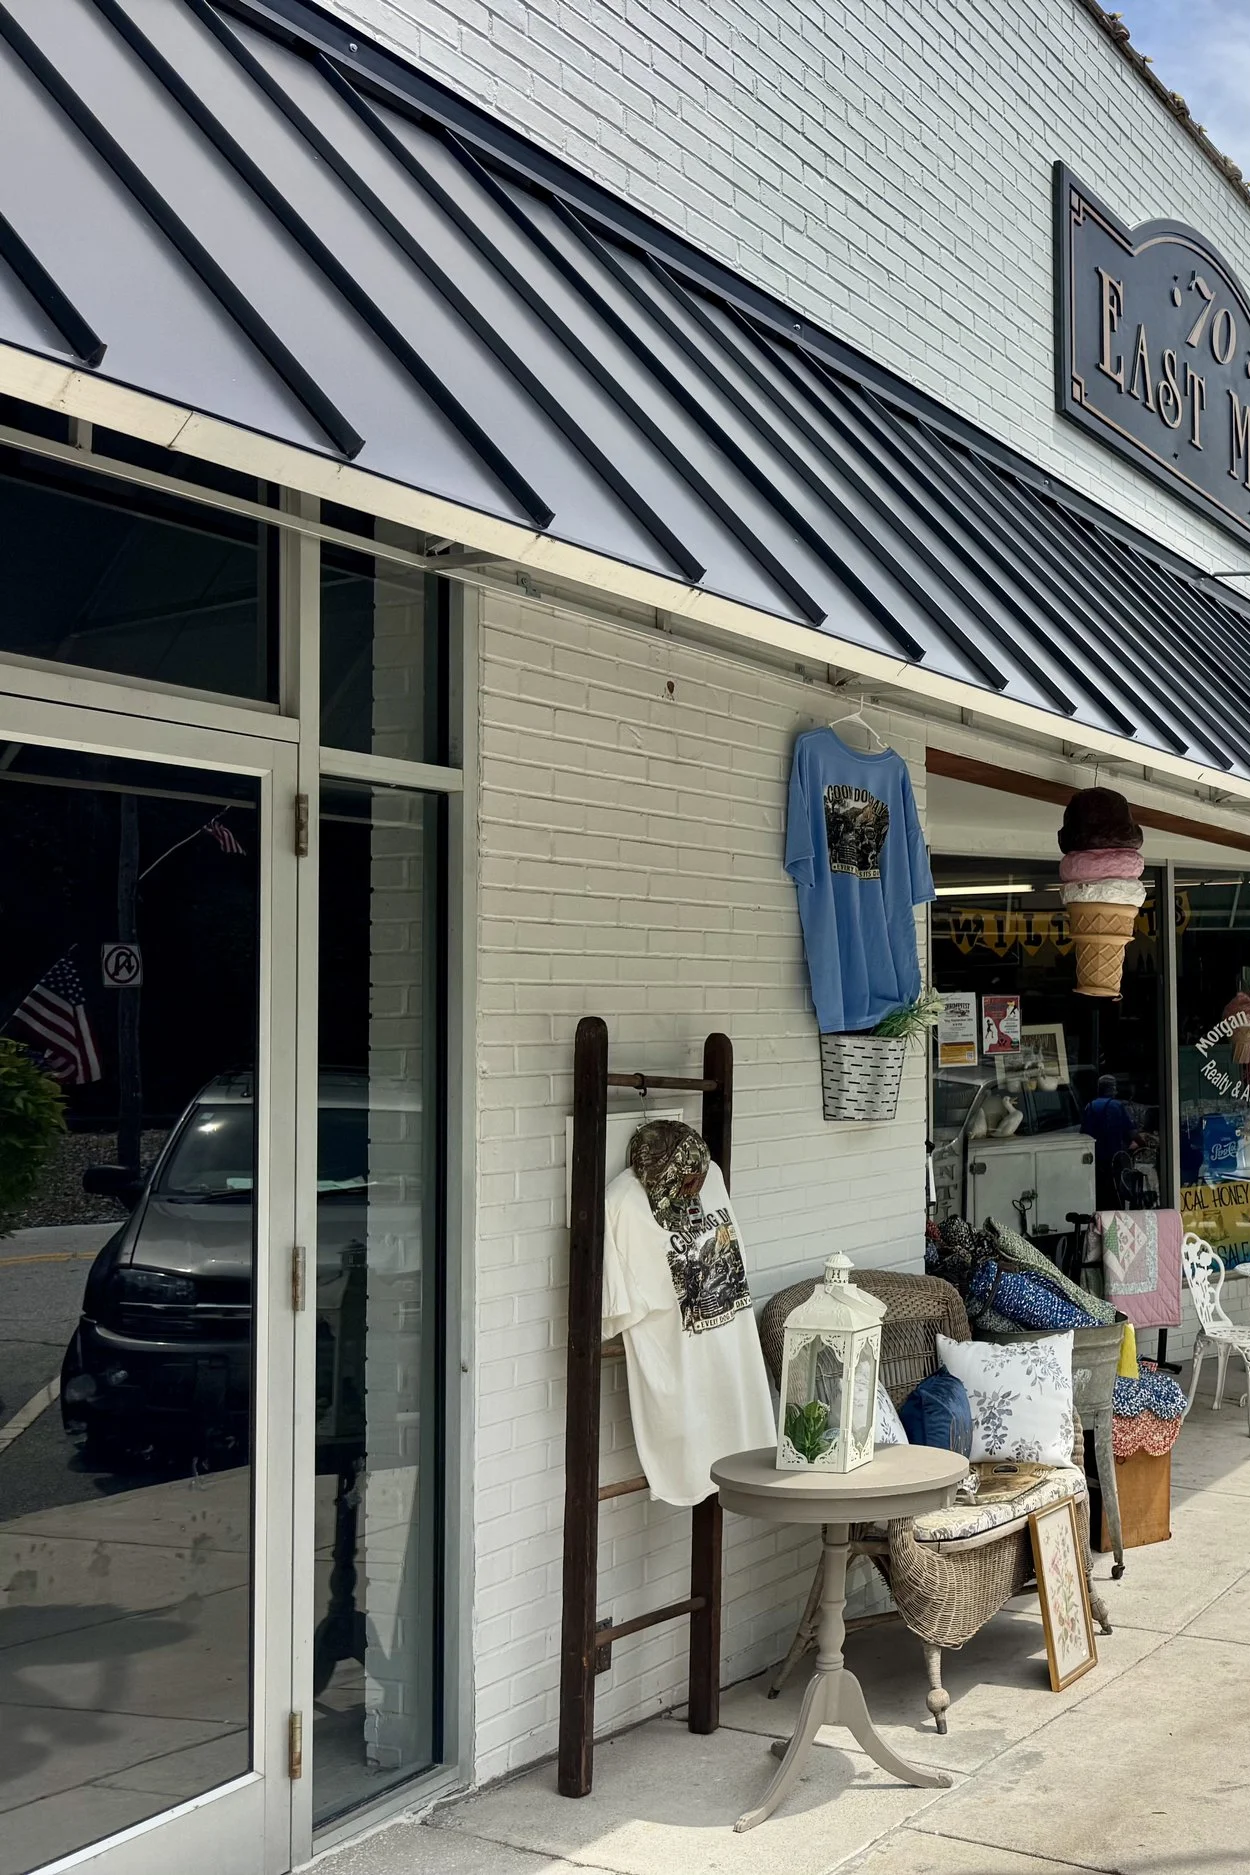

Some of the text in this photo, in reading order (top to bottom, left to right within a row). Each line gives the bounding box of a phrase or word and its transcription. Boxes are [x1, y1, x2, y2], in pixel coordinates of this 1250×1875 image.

[1187, 271, 1236, 364] 70
[1096, 266, 1206, 450] EAST
[1195, 1010, 1248, 1058] Morgan
[1200, 1059, 1233, 1096] Realty
[1231, 1081, 1242, 1098] &
[1212, 1183, 1249, 1208] HONEY
